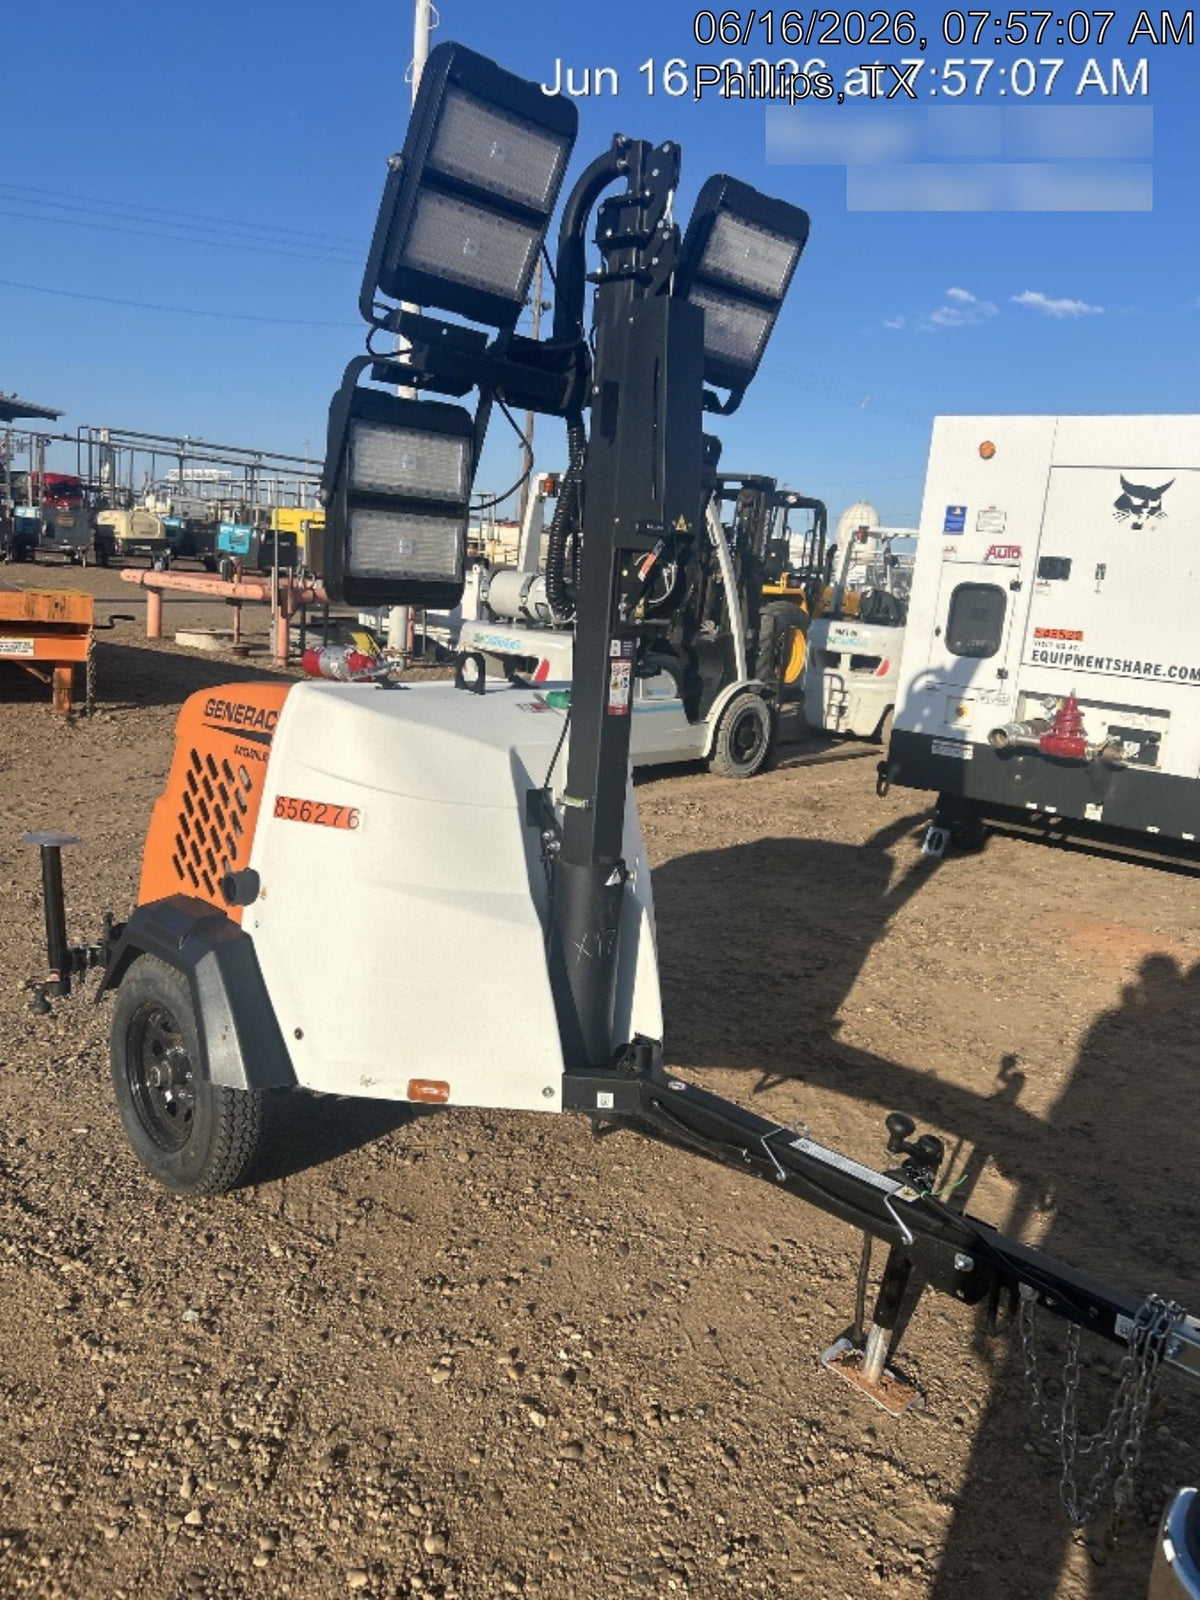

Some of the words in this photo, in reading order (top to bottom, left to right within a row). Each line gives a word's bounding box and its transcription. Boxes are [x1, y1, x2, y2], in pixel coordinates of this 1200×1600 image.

[1031, 650, 1200, 681] EQUIPMENTSHARE.COM
[204, 698, 279, 730] GENERAC
[275, 796, 361, 830] 656276
